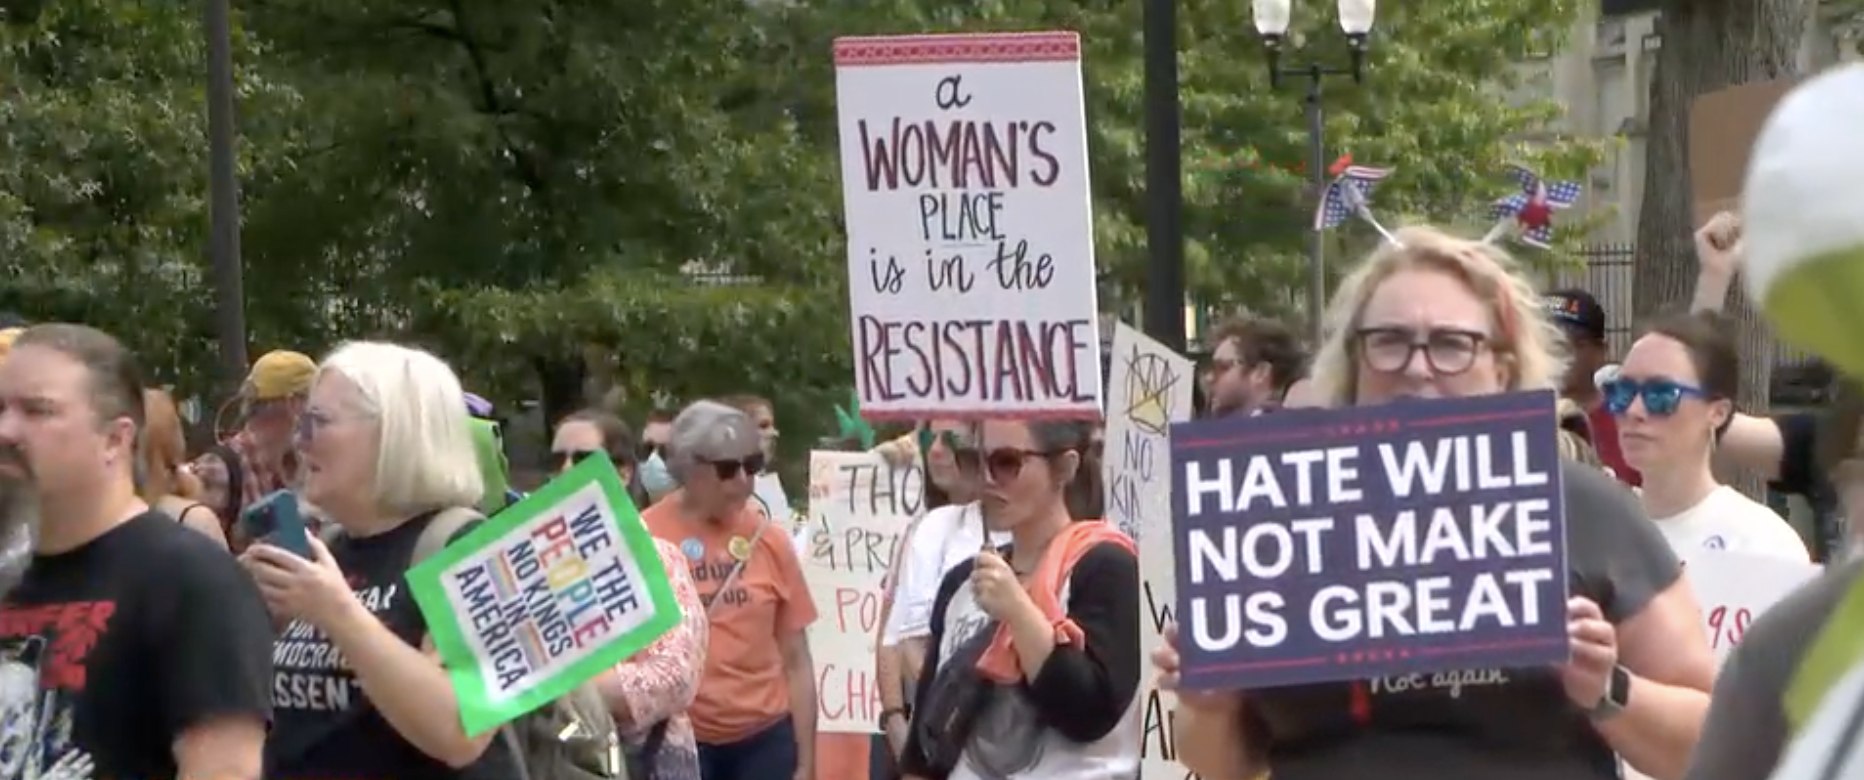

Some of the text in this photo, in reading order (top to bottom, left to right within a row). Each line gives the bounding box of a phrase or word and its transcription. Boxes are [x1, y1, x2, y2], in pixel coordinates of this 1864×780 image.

[935, 74, 972, 110] a
[858, 117, 1060, 191] WOMAN'S
[919, 192, 1006, 241] PLACE
[870, 240, 1055, 294] is in the
[858, 315, 1096, 402] RESISTANCE
[1123, 429, 1153, 482] NO
[1185, 430, 1549, 516] HATE WILL
[531, 515, 611, 649] PEOPLE
[569, 503, 639, 622] WE THE
[1188, 499, 1552, 584] NOT MAKE
[454, 564, 529, 691] AMERICA
[503, 596, 530, 629] IN
[507, 539, 574, 658] NO KINGS
[1191, 568, 1553, 652] US GREAT
[271, 671, 362, 712] SSEN
